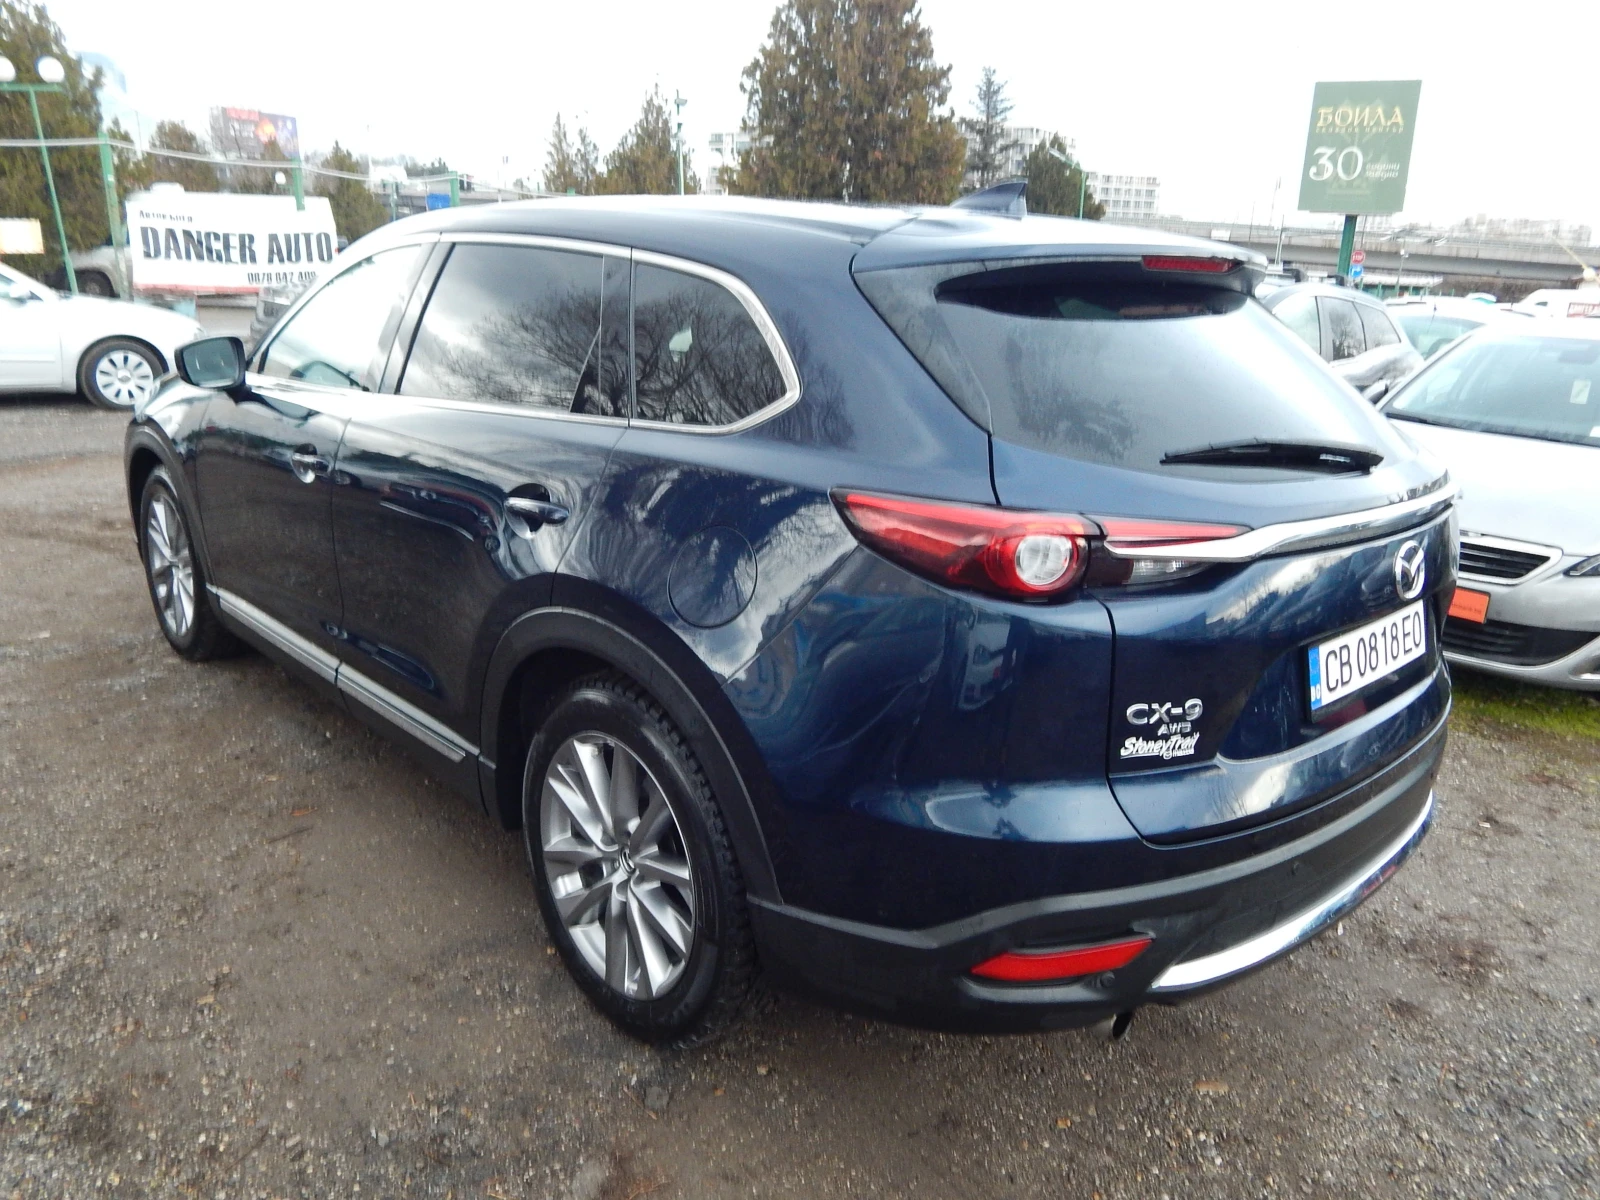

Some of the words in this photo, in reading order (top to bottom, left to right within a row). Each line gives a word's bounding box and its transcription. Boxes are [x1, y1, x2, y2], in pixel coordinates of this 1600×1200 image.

[1316, 106, 1404, 127] БОИЛА
[1309, 146, 1363, 181] 30
[140, 226, 257, 265] DANGER
[267, 232, 333, 265] AUTO
[1126, 698, 1203, 725] CX-9
